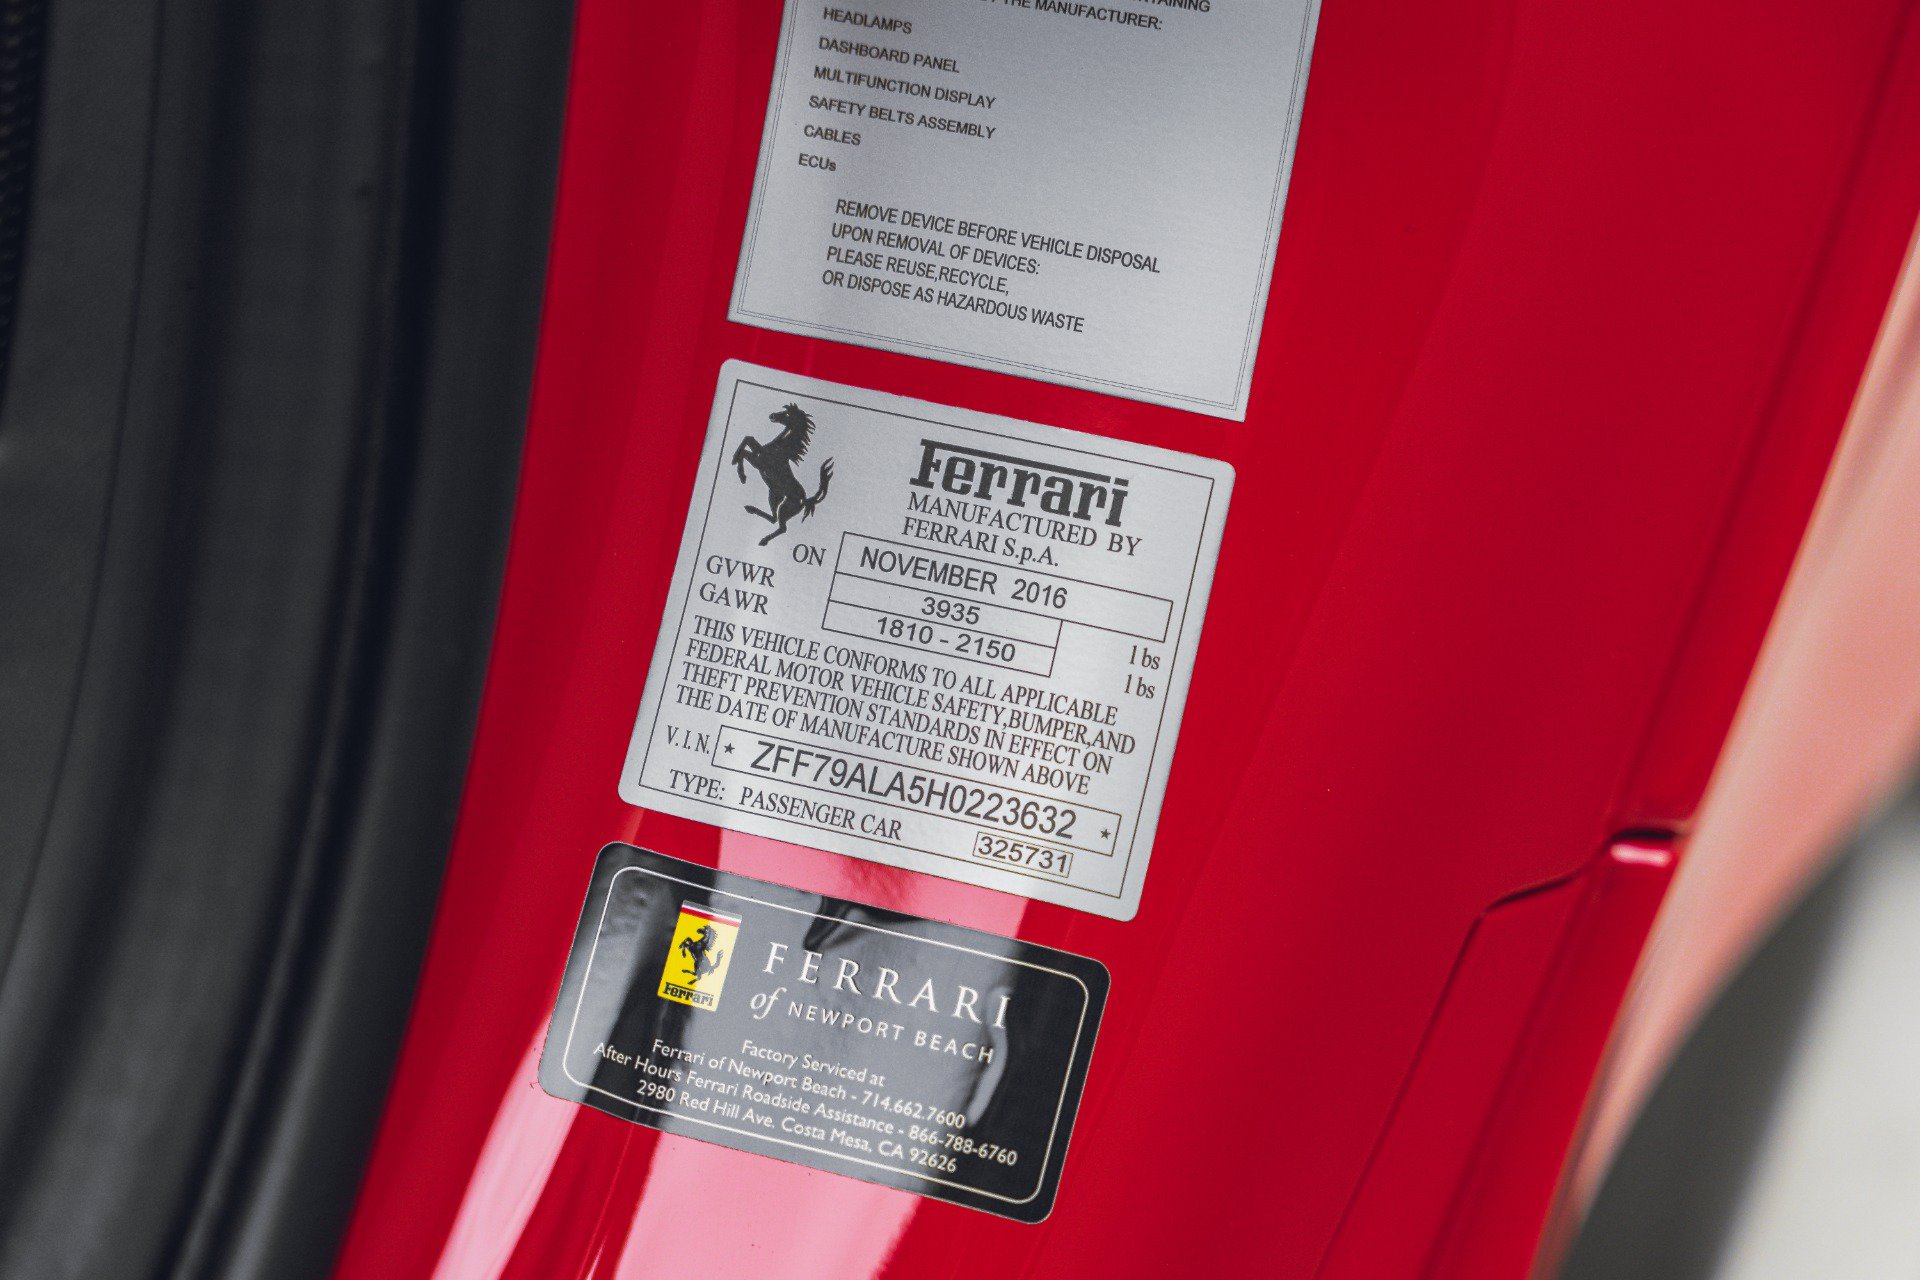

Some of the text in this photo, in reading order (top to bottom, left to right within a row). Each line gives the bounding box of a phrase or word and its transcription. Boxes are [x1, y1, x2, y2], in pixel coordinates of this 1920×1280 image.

[822, 6, 912, 35] HEADLAMPS
[1034, 0, 1164, 30] MANUFACTURER:
[818, 34, 960, 74] DASHBOARD PANEL
[813, 64, 996, 110] MULTIFUNCTION DISPLAY
[803, 123, 861, 146] CABLES
[808, 94, 996, 139] SAFETY BELTS ASSEMBLY
[797, 152, 836, 172] ECUs
[826, 245, 884, 270] PLEASE
[831, 222, 1040, 275] UPON REMOVAL OF DEVICES:
[834, 198, 1160, 274] REMOVE DEVICE BEFORE VEHICLE DISPOSAL
[821, 269, 1085, 333] OR DISPOSE AS HAZARDOUS WASTE
[908, 438, 1131, 529] Ferrari
[900, 516, 1058, 567] FERRARI S.p.A.
[906, 491, 1142, 556] MANUFACTURED BY
[705, 554, 775, 588] GVWR
[792, 543, 827, 567] ON
[859, 545, 1068, 609] NOVEMBER 2016
[699, 581, 768, 616] GAWR
[920, 596, 980, 625] 3935
[877, 616, 934, 644] 1810
[954, 632, 1016, 662] 2150
[684, 637, 772, 675] FEDERAL
[775, 658, 846, 692] MOTOR
[850, 673, 930, 710] VEHICLE
[693, 614, 1118, 726] THIS VEHICLE CONFORMS TO ALL APPLICABLE
[675, 683, 1091, 795] THE DATE OF MANUFACTURE SHOWN ABOVE
[681, 660, 1114, 775] THEFT PREVENTION STANDARDS IN EFFECT ON
[669, 768, 902, 841] TYPE: PASSENGER CAR
[749, 740, 1076, 840] ZFF79ALA5H0223632
[977, 834, 1069, 875] 325731
[661, 981, 716, 1008] Ferrari
[762, 941, 1010, 1028] FERRARI
[749, 986, 994, 1063] of NEWPORT BEACH
[651, 1037, 705, 1065] Ferrari
[708, 1056, 727, 1069] of
[727, 1058, 797, 1088] Newport
[801, 1076, 846, 1100] Beach
[861, 1090, 966, 1129] 714.662.7600
[740, 1039, 886, 1087] Factory Serviced at
[593, 1041, 632, 1066] After
[634, 1054, 682, 1083] Hours
[686, 1070, 738, 1096] Ferrari
[742, 1084, 810, 1114] Roadside
[813, 1102, 894, 1134] Assistance
[908, 1124, 1019, 1167] 866-788-6760
[635, 1078, 676, 1102] 2980
[679, 1090, 710, 1111] Red
[712, 1099, 739, 1118] Hill
[781, 1116, 825, 1140] Costa
[878, 1140, 903, 1159] CA
[909, 1146, 957, 1173] 92626
